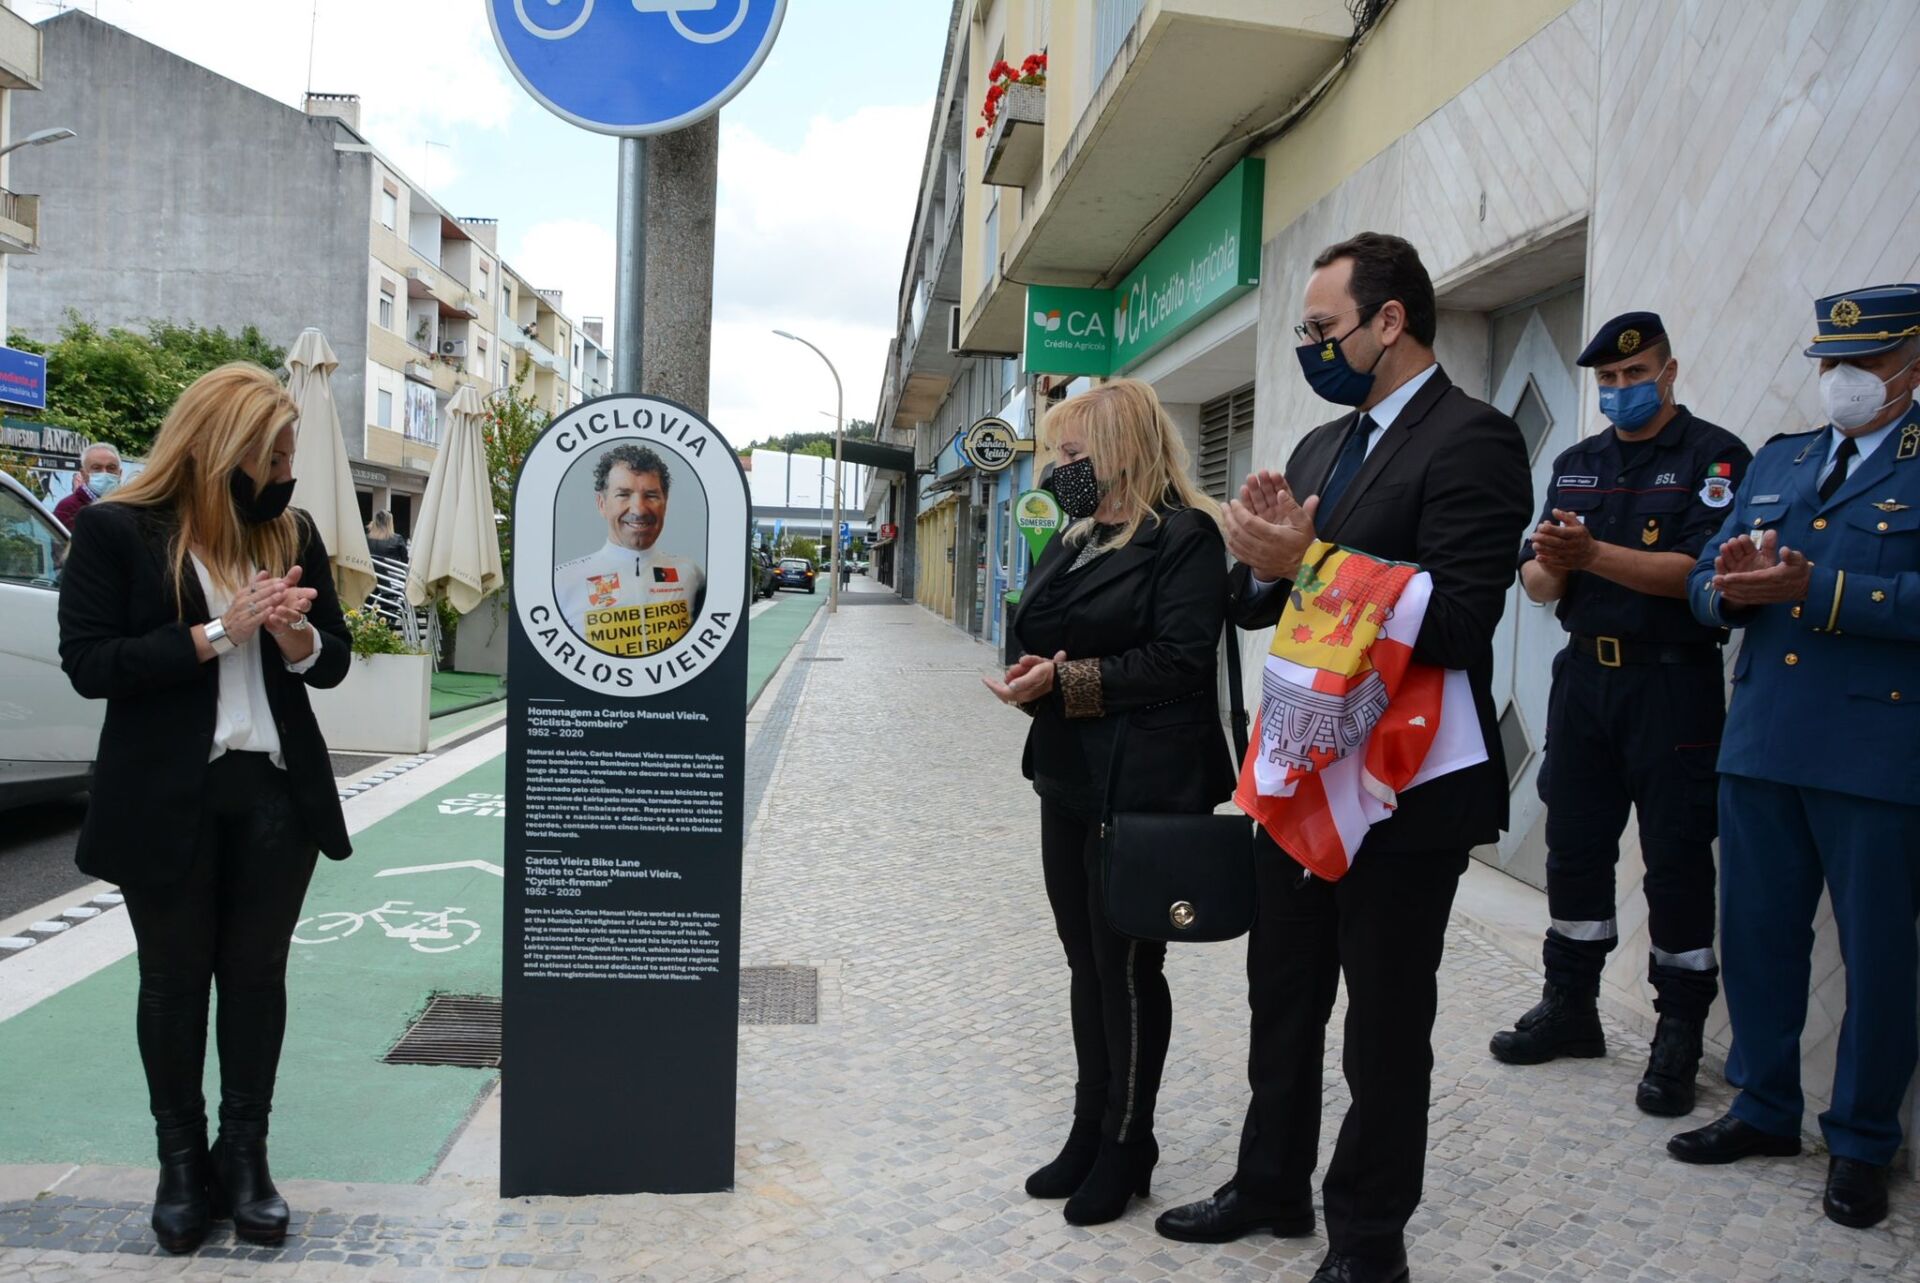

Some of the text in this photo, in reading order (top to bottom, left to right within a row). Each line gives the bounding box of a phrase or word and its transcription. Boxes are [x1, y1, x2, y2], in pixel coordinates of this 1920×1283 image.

[1128, 228, 1236, 344] CA Crédito Agrícola
[1068, 311, 1105, 337] CA
[1044, 340, 1073, 349] Crédito
[556, 408, 708, 458] CICLOVIA
[977, 438, 1005, 448] Sandes
[1655, 473, 1677, 485] BSL
[1020, 518, 1056, 527] SOMERSBY
[591, 618, 689, 642] MUNICIPAIS
[530, 605, 732, 687] CARLOS VIEIRA
[528, 707, 592, 718] Homenagem
[601, 709, 635, 718] Carlos
[636, 710, 674, 720] Manuel
[676, 711, 708, 722] Vieira,
[527, 728, 584, 738] 1952 2020
[640, 761, 680, 770] Municipais
[526, 767, 546, 776] longo
[526, 785, 570, 794] Apaixonado
[572, 786, 588, 795] pelo
[603, 796, 620, 804] pelo
[644, 806, 693, 815] Representou
[526, 812, 562, 821] regionais
[525, 856, 640, 867] Carlos Vieira Bike Lane
[525, 867, 681, 880] Tribute to Carlos Manuel Vieira,
[525, 887, 581, 896] 1952 2020
[547, 917, 582, 926] Municipal
[584, 918, 625, 927] Firefighters
[524, 926, 542, 934] wing
[531, 935, 573, 944] passionate
[661, 938, 688, 946] bicycle
[571, 944, 611, 954] throughout
[544, 953, 576, 962] greatest
[642, 955, 687, 964] represented
[688, 956, 718, 964] regional
[659, 964, 686, 973] setting
[560, 971, 606, 980] registrations
